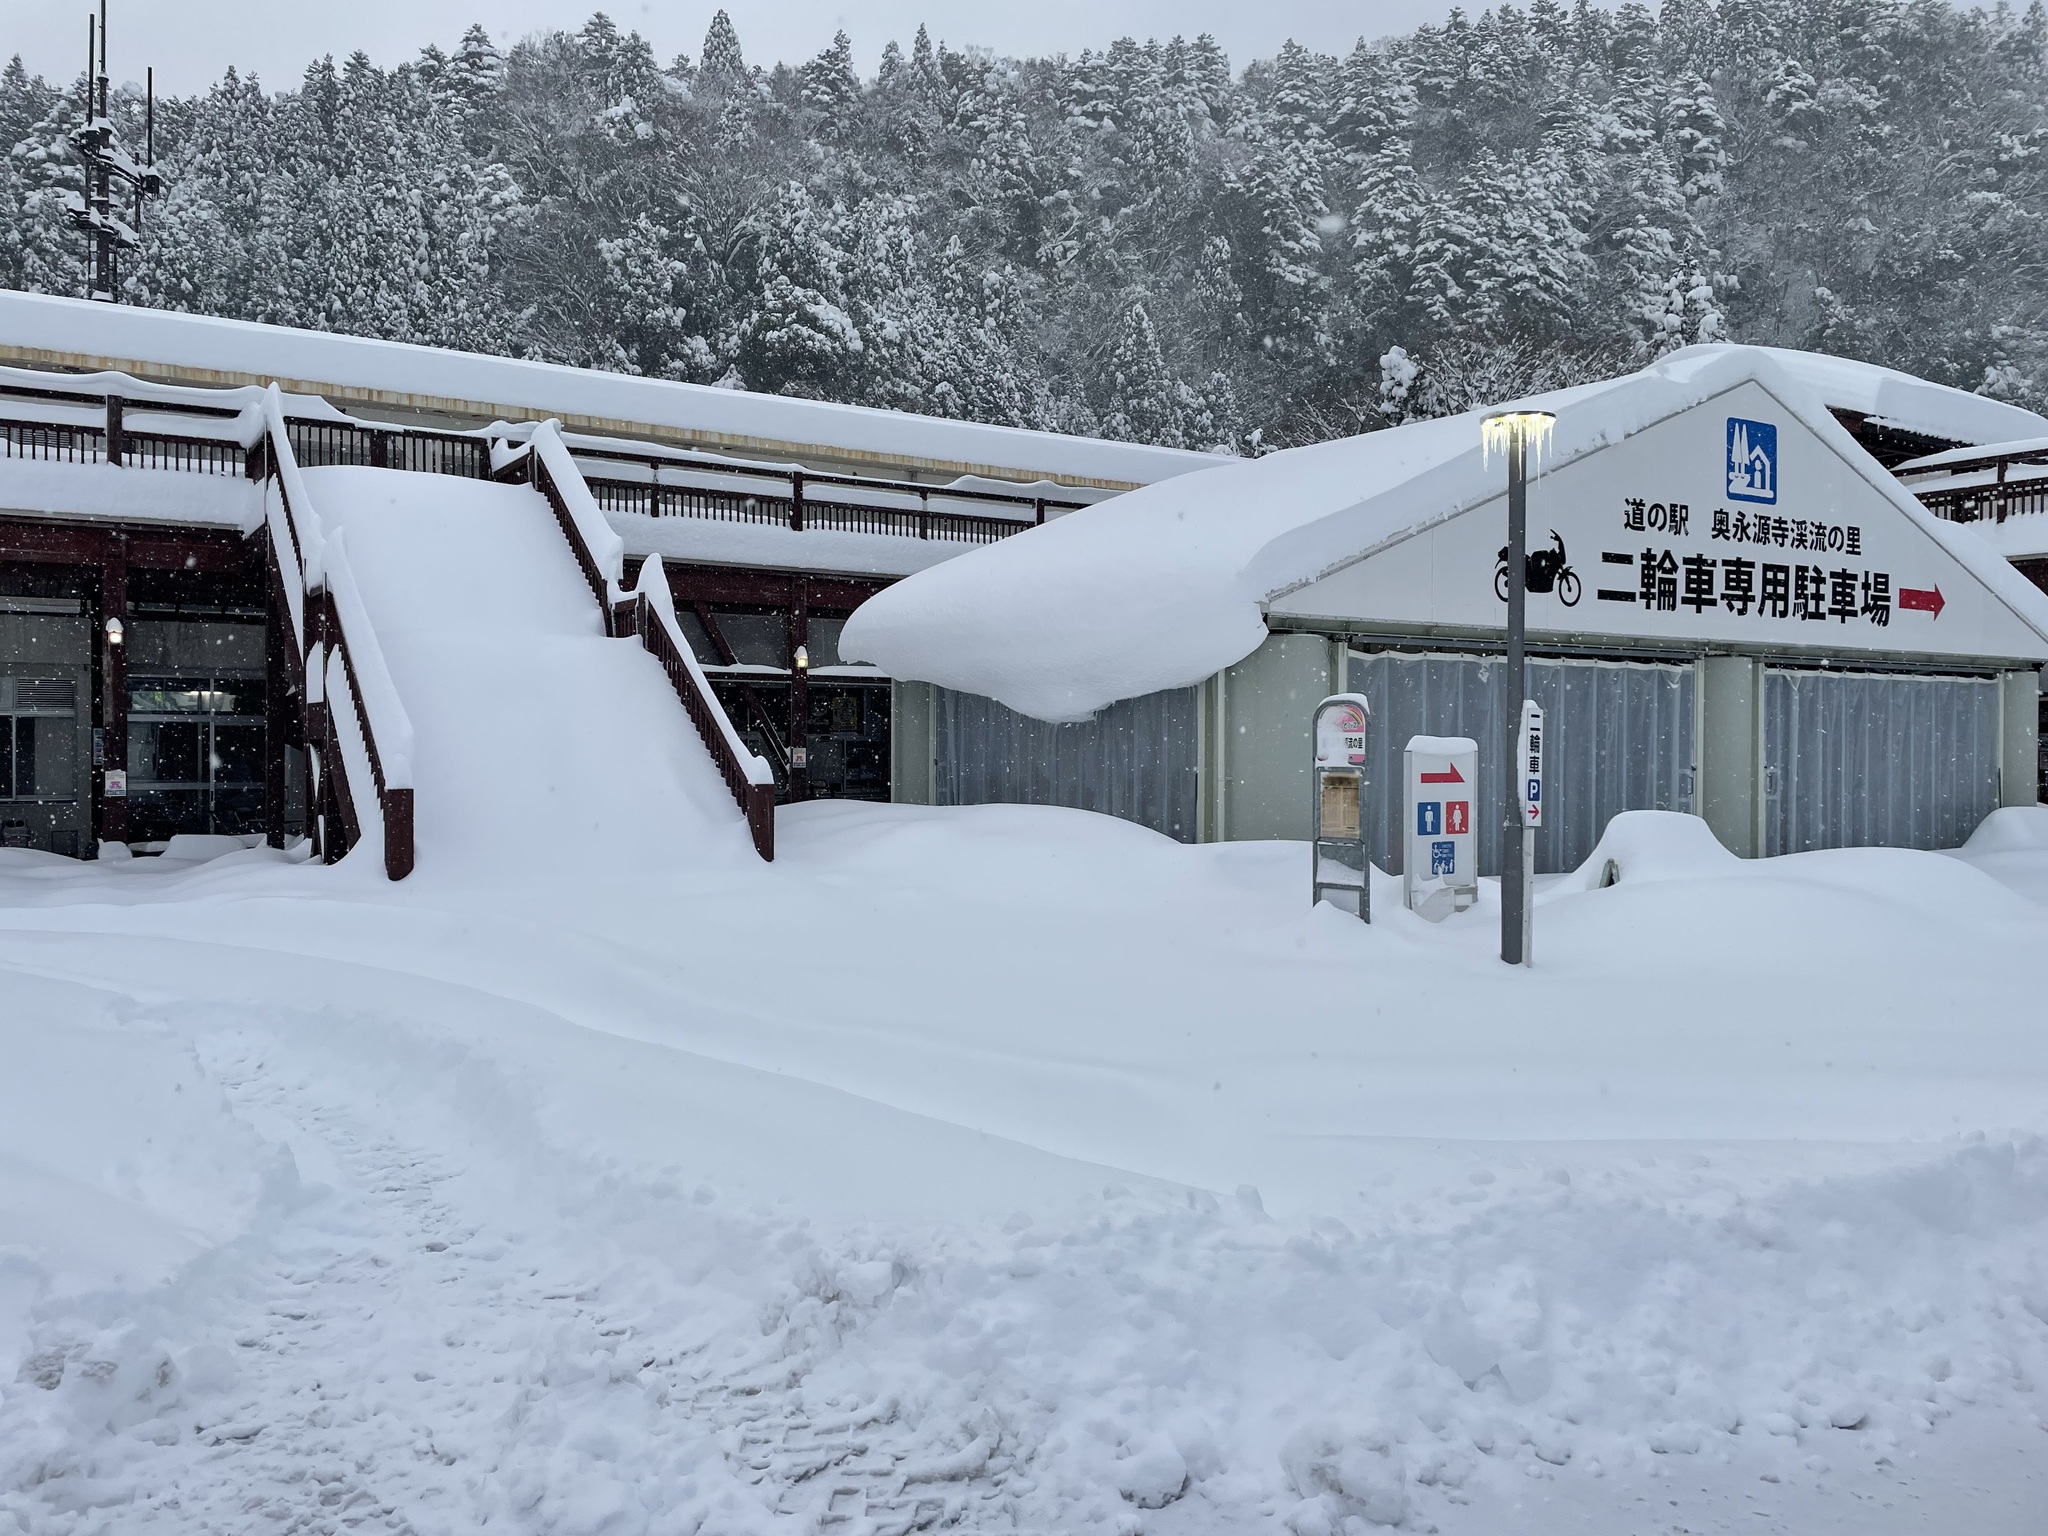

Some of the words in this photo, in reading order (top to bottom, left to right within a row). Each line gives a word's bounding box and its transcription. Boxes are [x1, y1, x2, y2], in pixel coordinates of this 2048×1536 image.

[1624, 498, 1689, 536] 道の駅
[1711, 508, 1862, 556] 奥永源寺渓流の里
[1597, 547, 1892, 627] 二輪車専用駐車場
[1529, 714, 1541, 775] 二輪車
[1530, 781, 1538, 799] P
